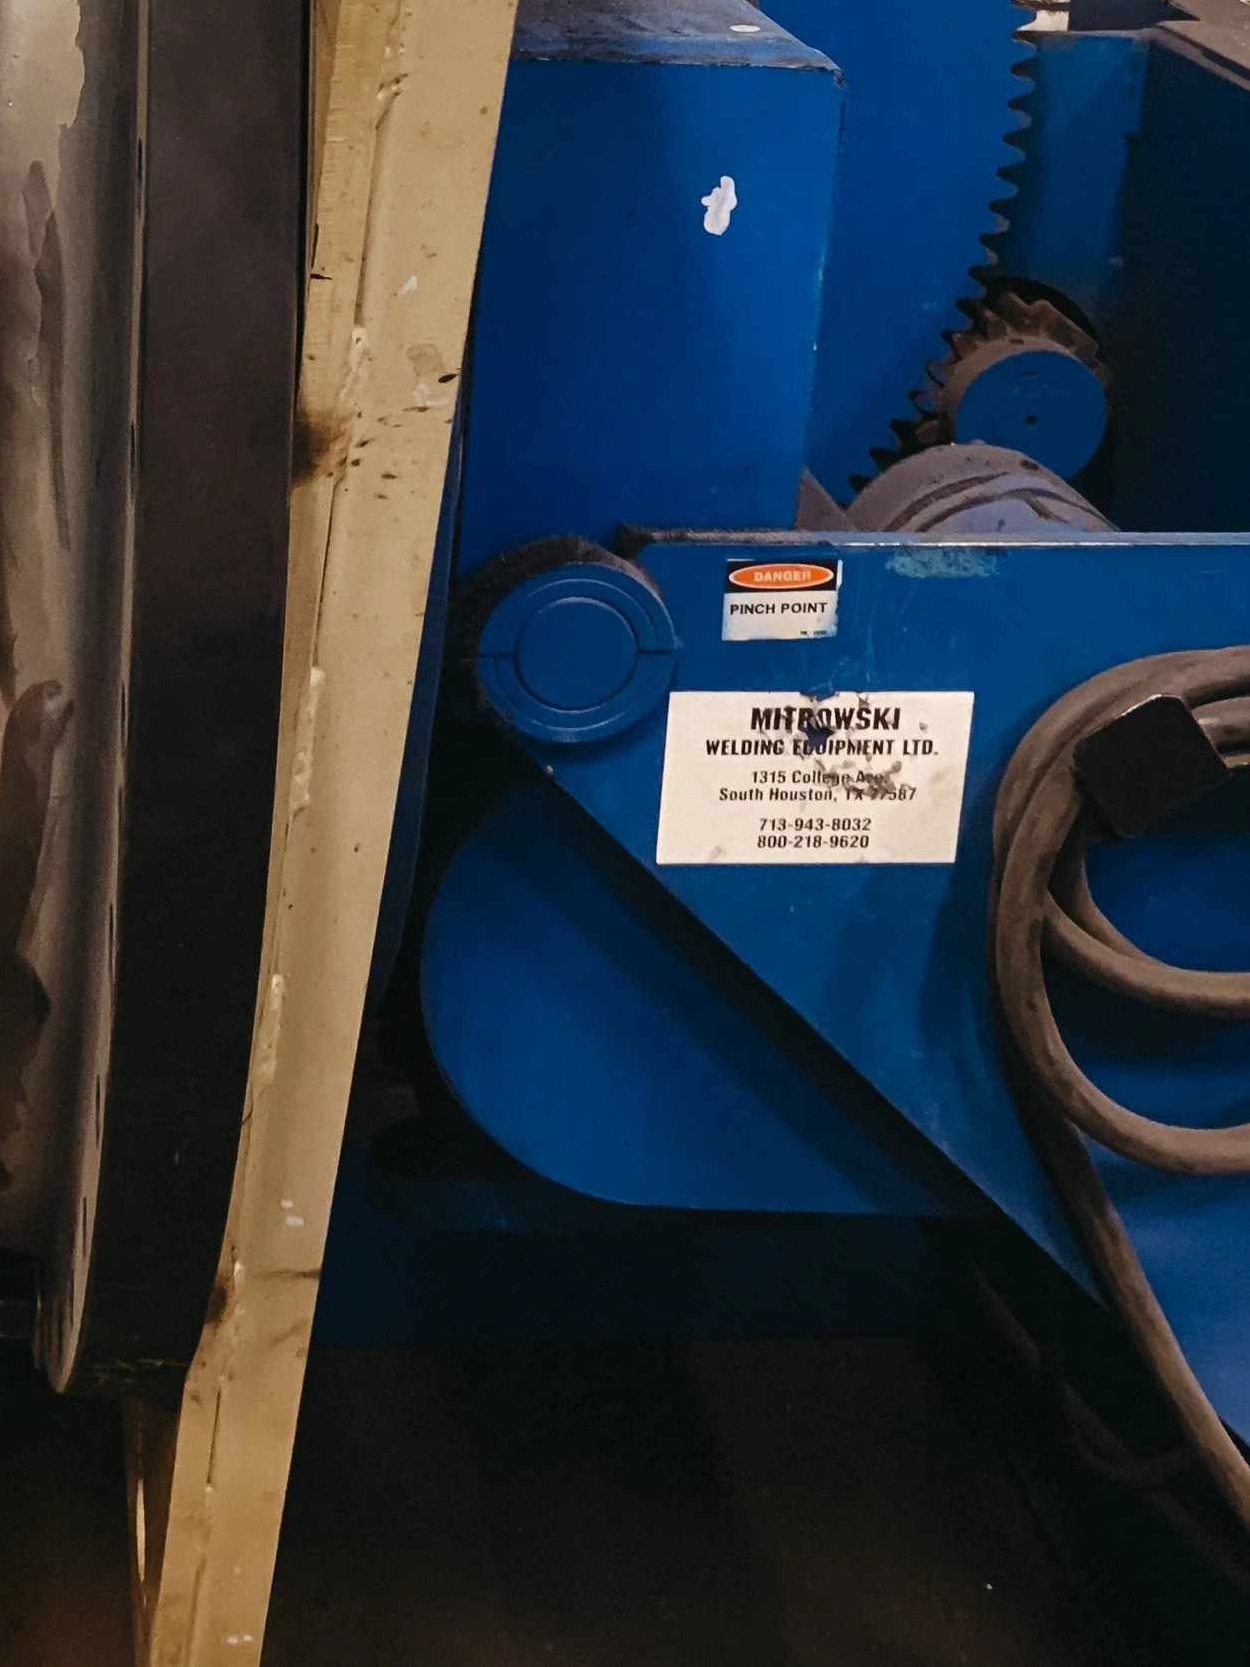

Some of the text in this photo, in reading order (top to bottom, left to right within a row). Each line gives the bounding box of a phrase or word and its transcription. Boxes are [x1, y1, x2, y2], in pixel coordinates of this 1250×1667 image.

[753, 570, 812, 582] DANGER
[730, 601, 828, 615] PINCH POINT
[750, 706, 901, 731] MITROWSKI
[705, 739, 785, 756] WELDING
[902, 739, 939, 756] LTD.
[752, 770, 787, 784] 1315
[718, 787, 764, 801] South
[768, 787, 838, 803] Houston,
[758, 818, 872, 832] 713-943-8032
[756, 835, 870, 849] 800-218-9620
